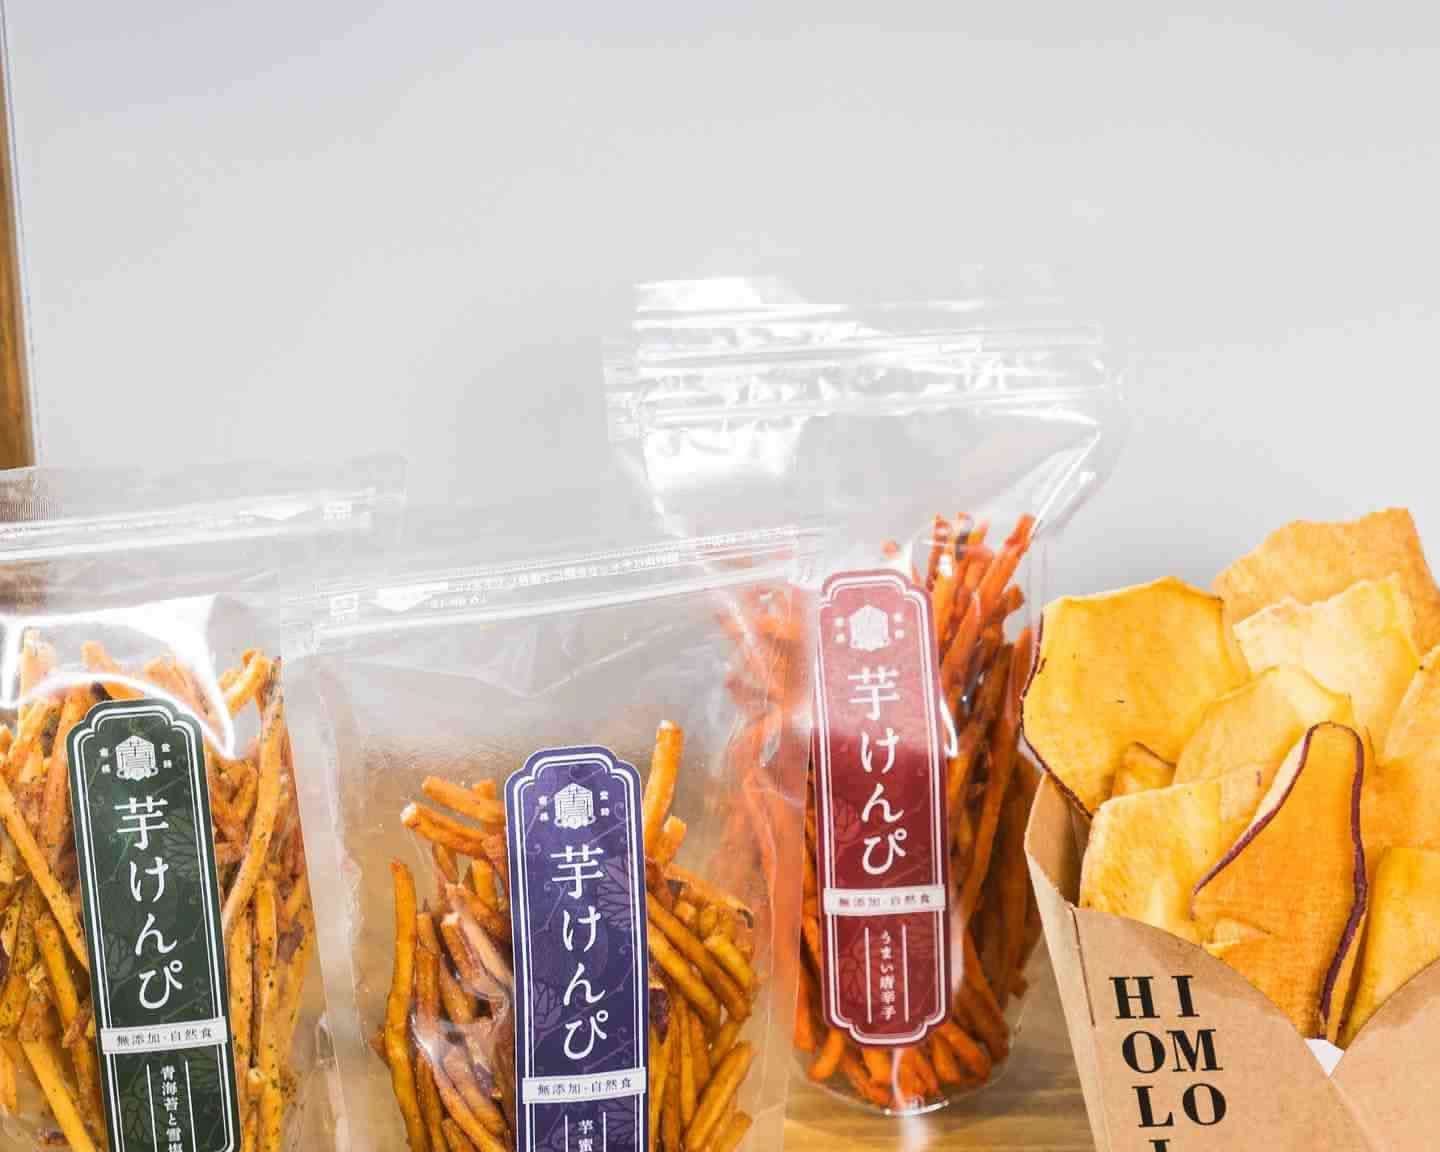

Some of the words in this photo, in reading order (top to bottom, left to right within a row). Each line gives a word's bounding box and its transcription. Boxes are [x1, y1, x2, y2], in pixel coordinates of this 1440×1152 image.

[848, 666, 907, 876] 芋けんぴ
[113, 796, 183, 1011] 芋けんぴ
[550, 845, 610, 1061] 芋けんぴ
